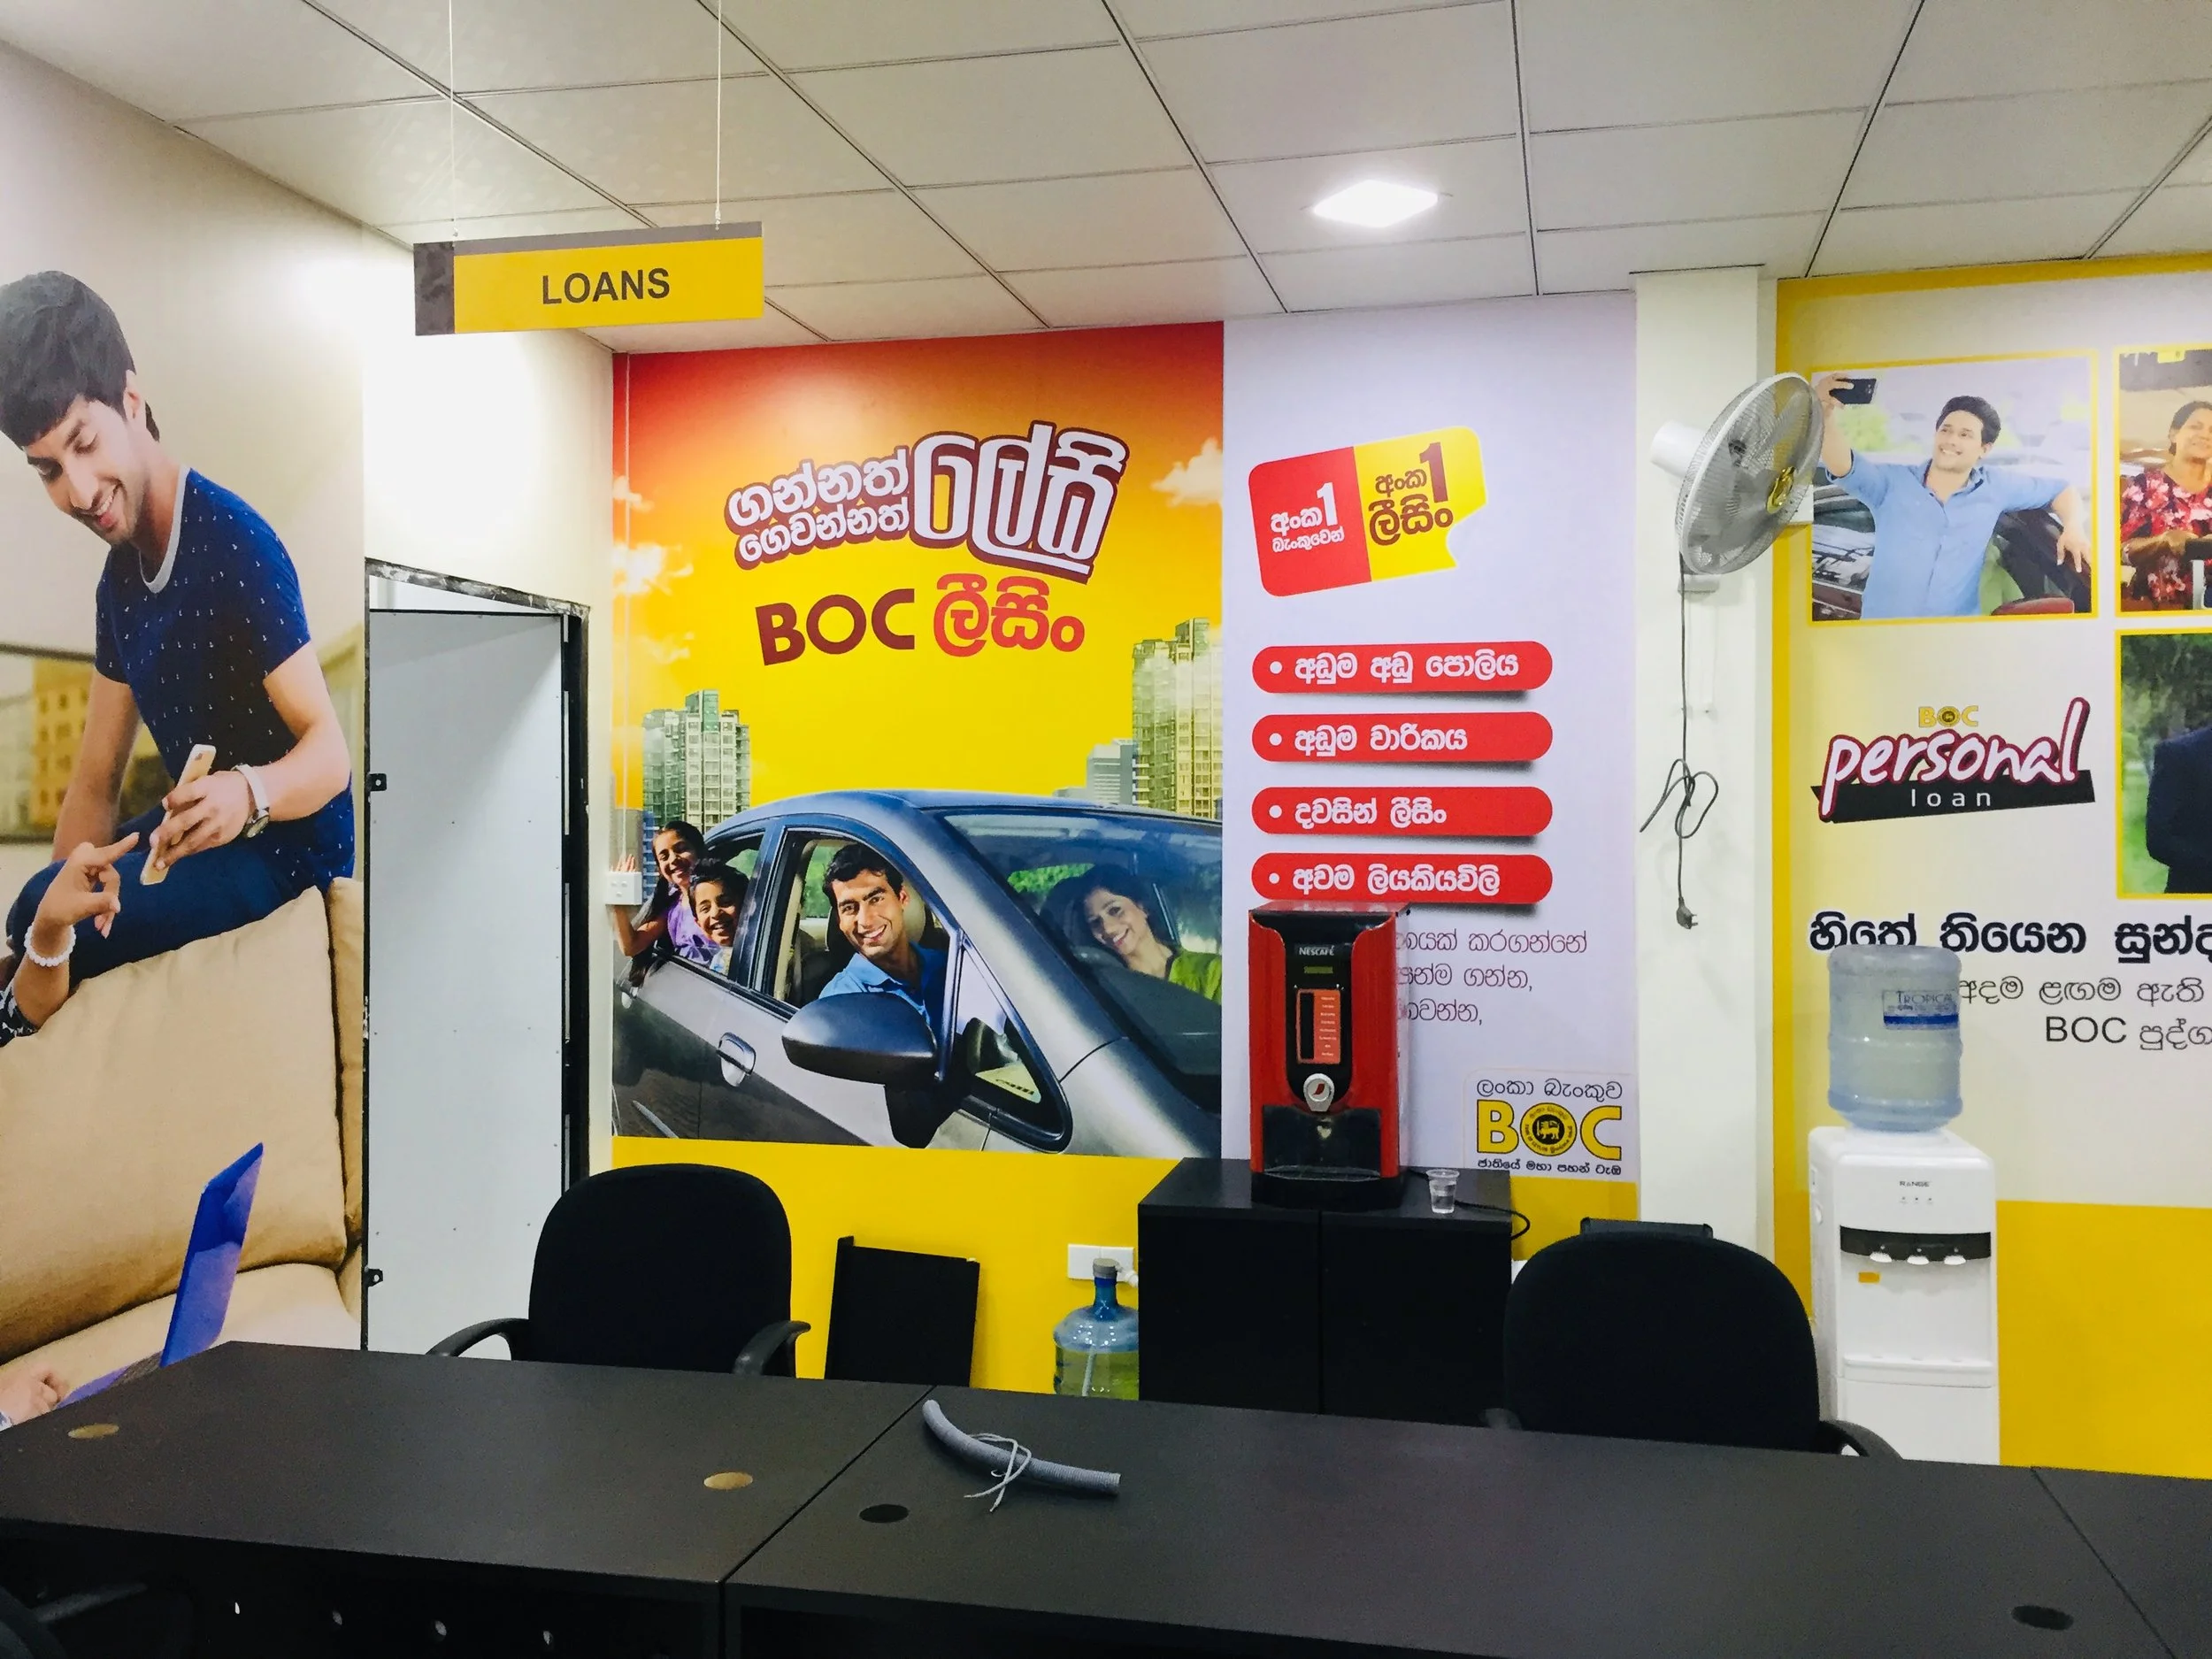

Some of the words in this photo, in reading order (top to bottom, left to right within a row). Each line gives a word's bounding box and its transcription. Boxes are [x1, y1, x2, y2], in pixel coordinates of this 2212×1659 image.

[542, 267, 671, 304] LOANS
[726, 444, 910, 528] ගන්නත්
[1375, 469, 1427, 497] අංක
[1419, 442, 1448, 503] 1
[1271, 506, 1323, 536] අංක
[1317, 481, 1338, 526] 1
[1368, 493, 1454, 546] ලීසිං
[737, 495, 911, 565] ගෙවන්නත්
[1271, 525, 1345, 552] බැංකුවෙන්
[755, 588, 915, 666] BOC
[933, 573, 1086, 657] ලීසිං
[1294, 652, 1358, 685] අඩුම
[1370, 651, 1413, 684] අඩු
[1425, 649, 1519, 680] පොලිය
[1918, 705, 1979, 728] BOC
[1294, 725, 1357, 757] අඩුම
[1370, 723, 1468, 751] වාරිකය
[1817, 696, 2091, 819] personal
[1294, 797, 1377, 829] දවසින්
[1390, 796, 1447, 828] ලීසිං
[1910, 788, 1992, 807] loan
[1292, 864, 1356, 895] අවම
[1367, 863, 1500, 896] ලියකියවිලි
[1469, 928, 1587, 954] කරගන්නේ
[1809, 910, 1918, 951] හිතේ
[1939, 911, 2087, 955] තියෙන
[1463, 964, 1532, 992] ගන්න,
[2137, 976, 2206, 1007] ඇති
[2045, 1016, 2127, 1044] BOC
[1477, 1079, 1534, 1098] ලංකා
[1544, 1078, 1624, 1103] බැංකුව
[1477, 1099, 1623, 1161] BOC
[1477, 1158, 1522, 1171] ජාතියේ
[1525, 1160, 1553, 1172] මහා
[1556, 1162, 1591, 1175] පහන්
